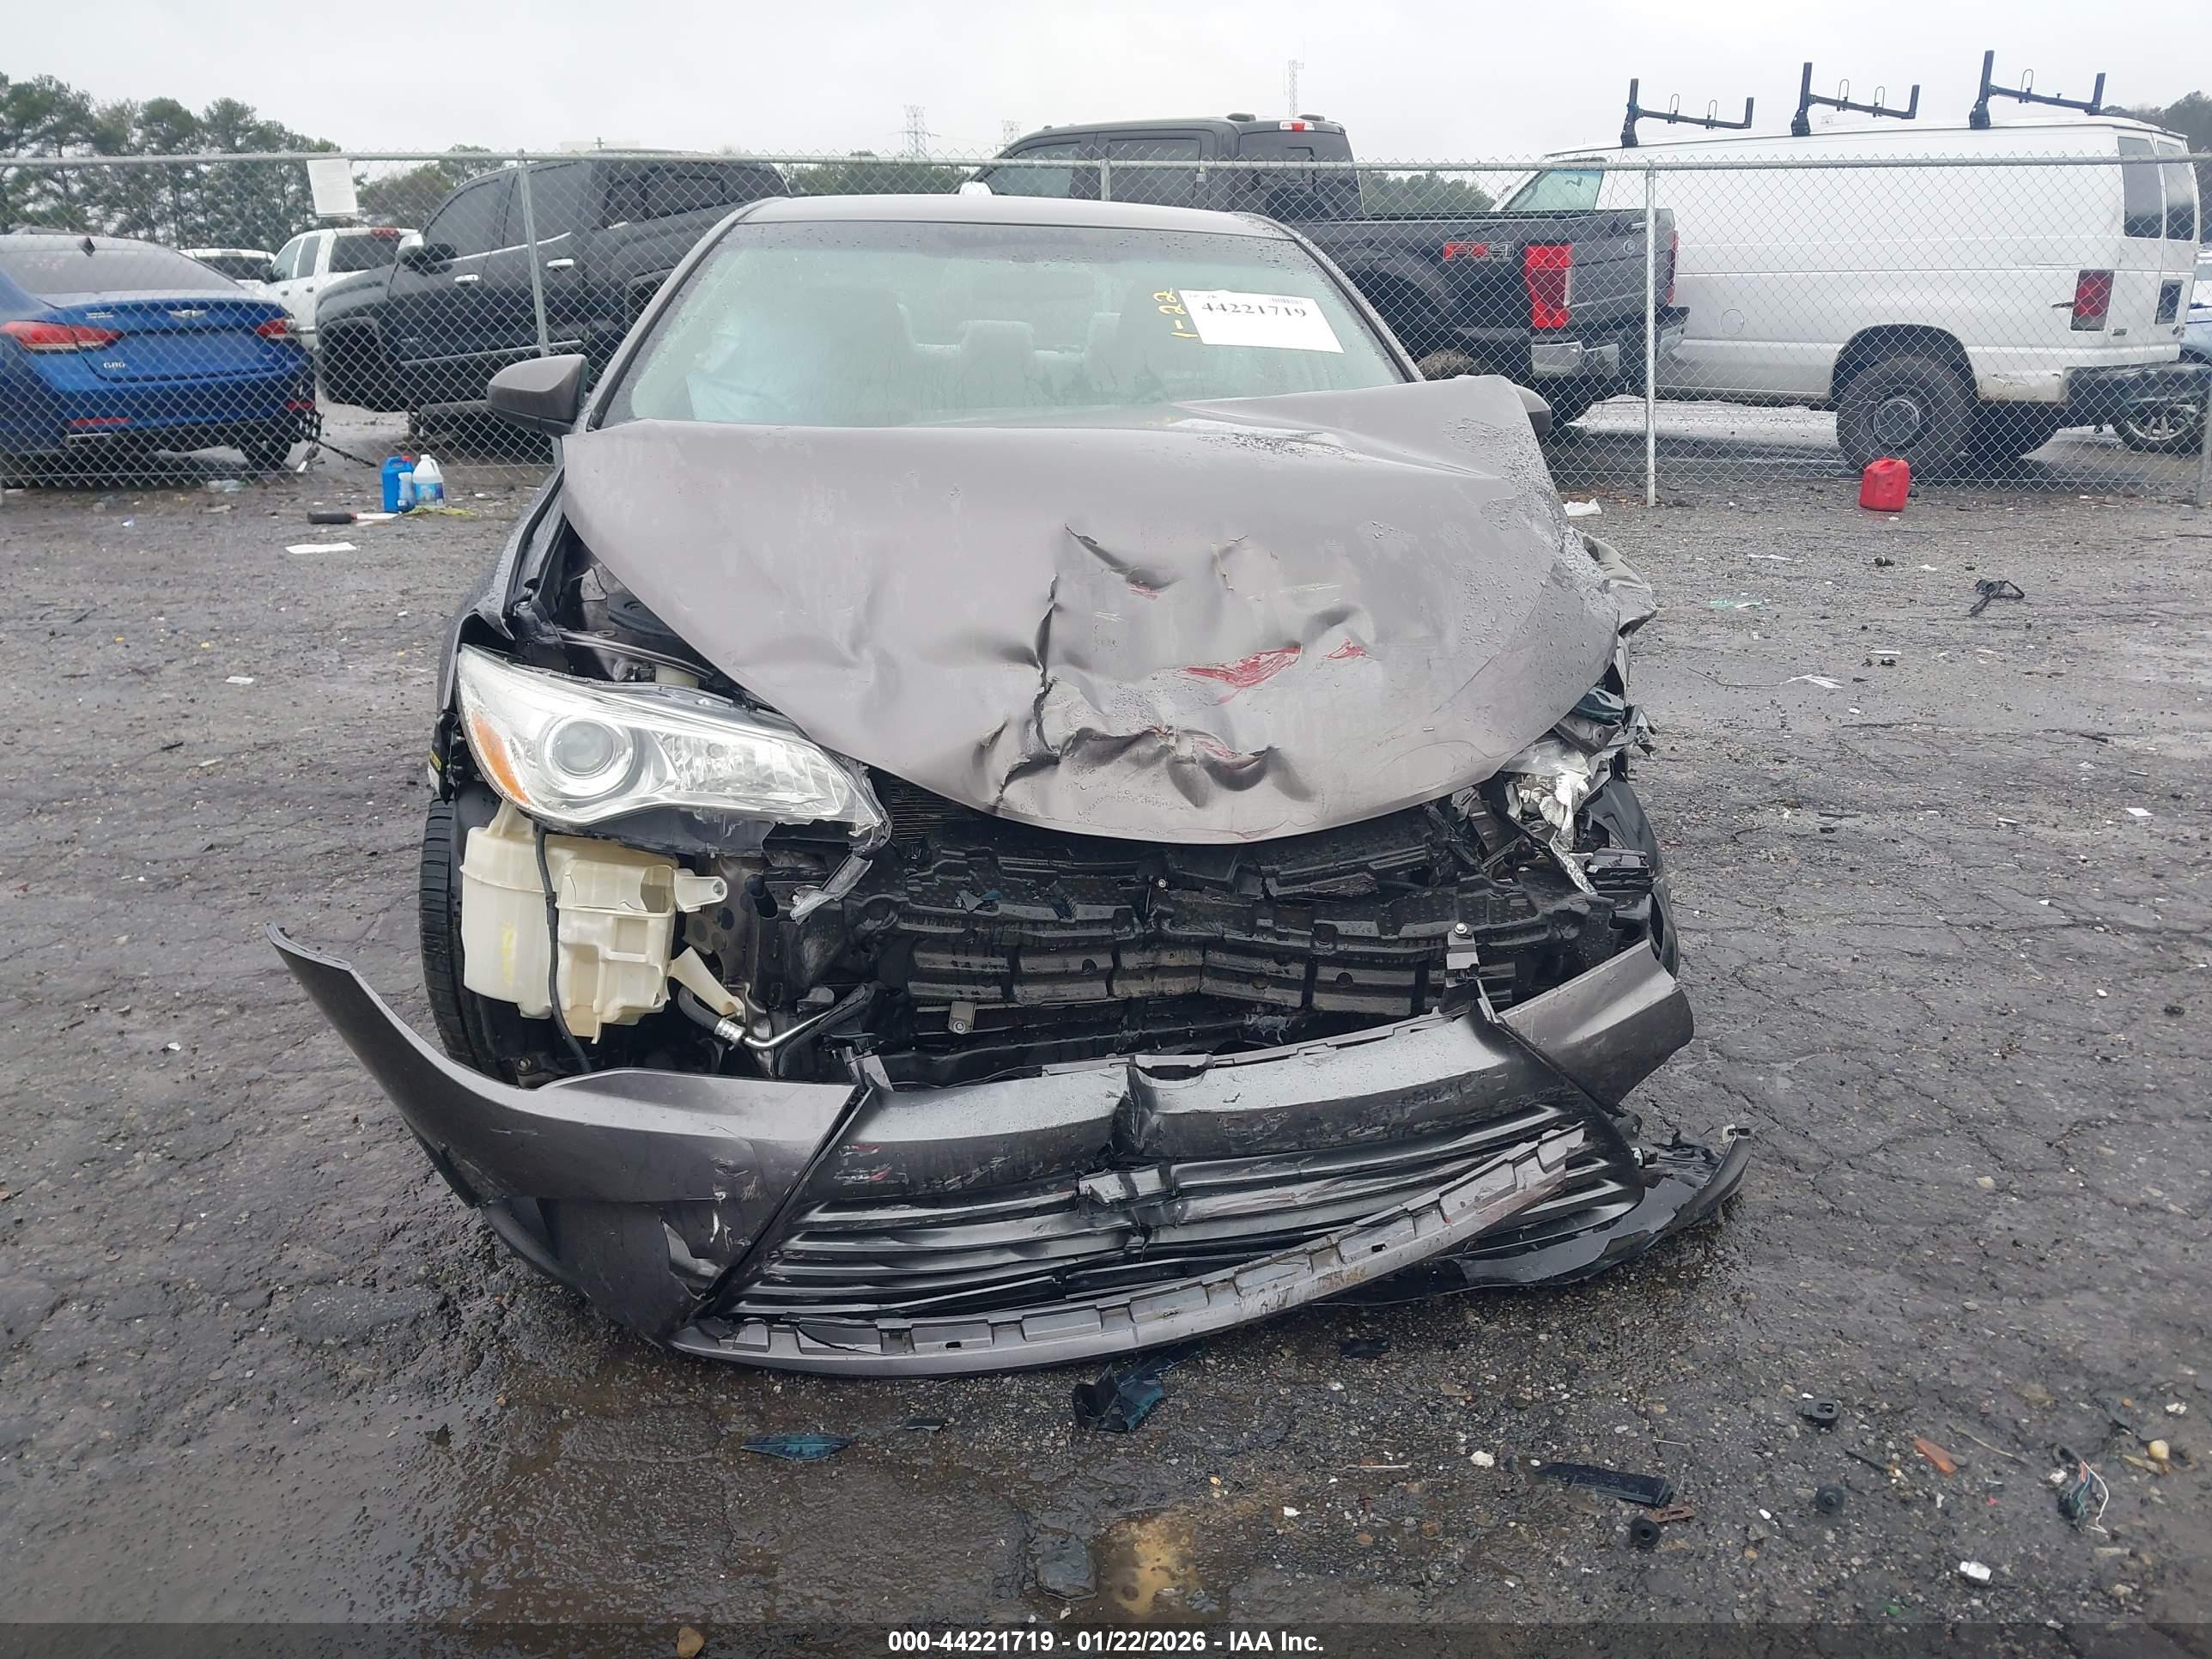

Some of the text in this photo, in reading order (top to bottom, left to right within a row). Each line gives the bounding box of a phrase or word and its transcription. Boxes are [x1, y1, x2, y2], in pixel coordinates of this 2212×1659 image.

[1443, 240, 1516, 262] FX4
[1201, 301, 1308, 318] 44221719
[102, 361, 126, 369] G80
